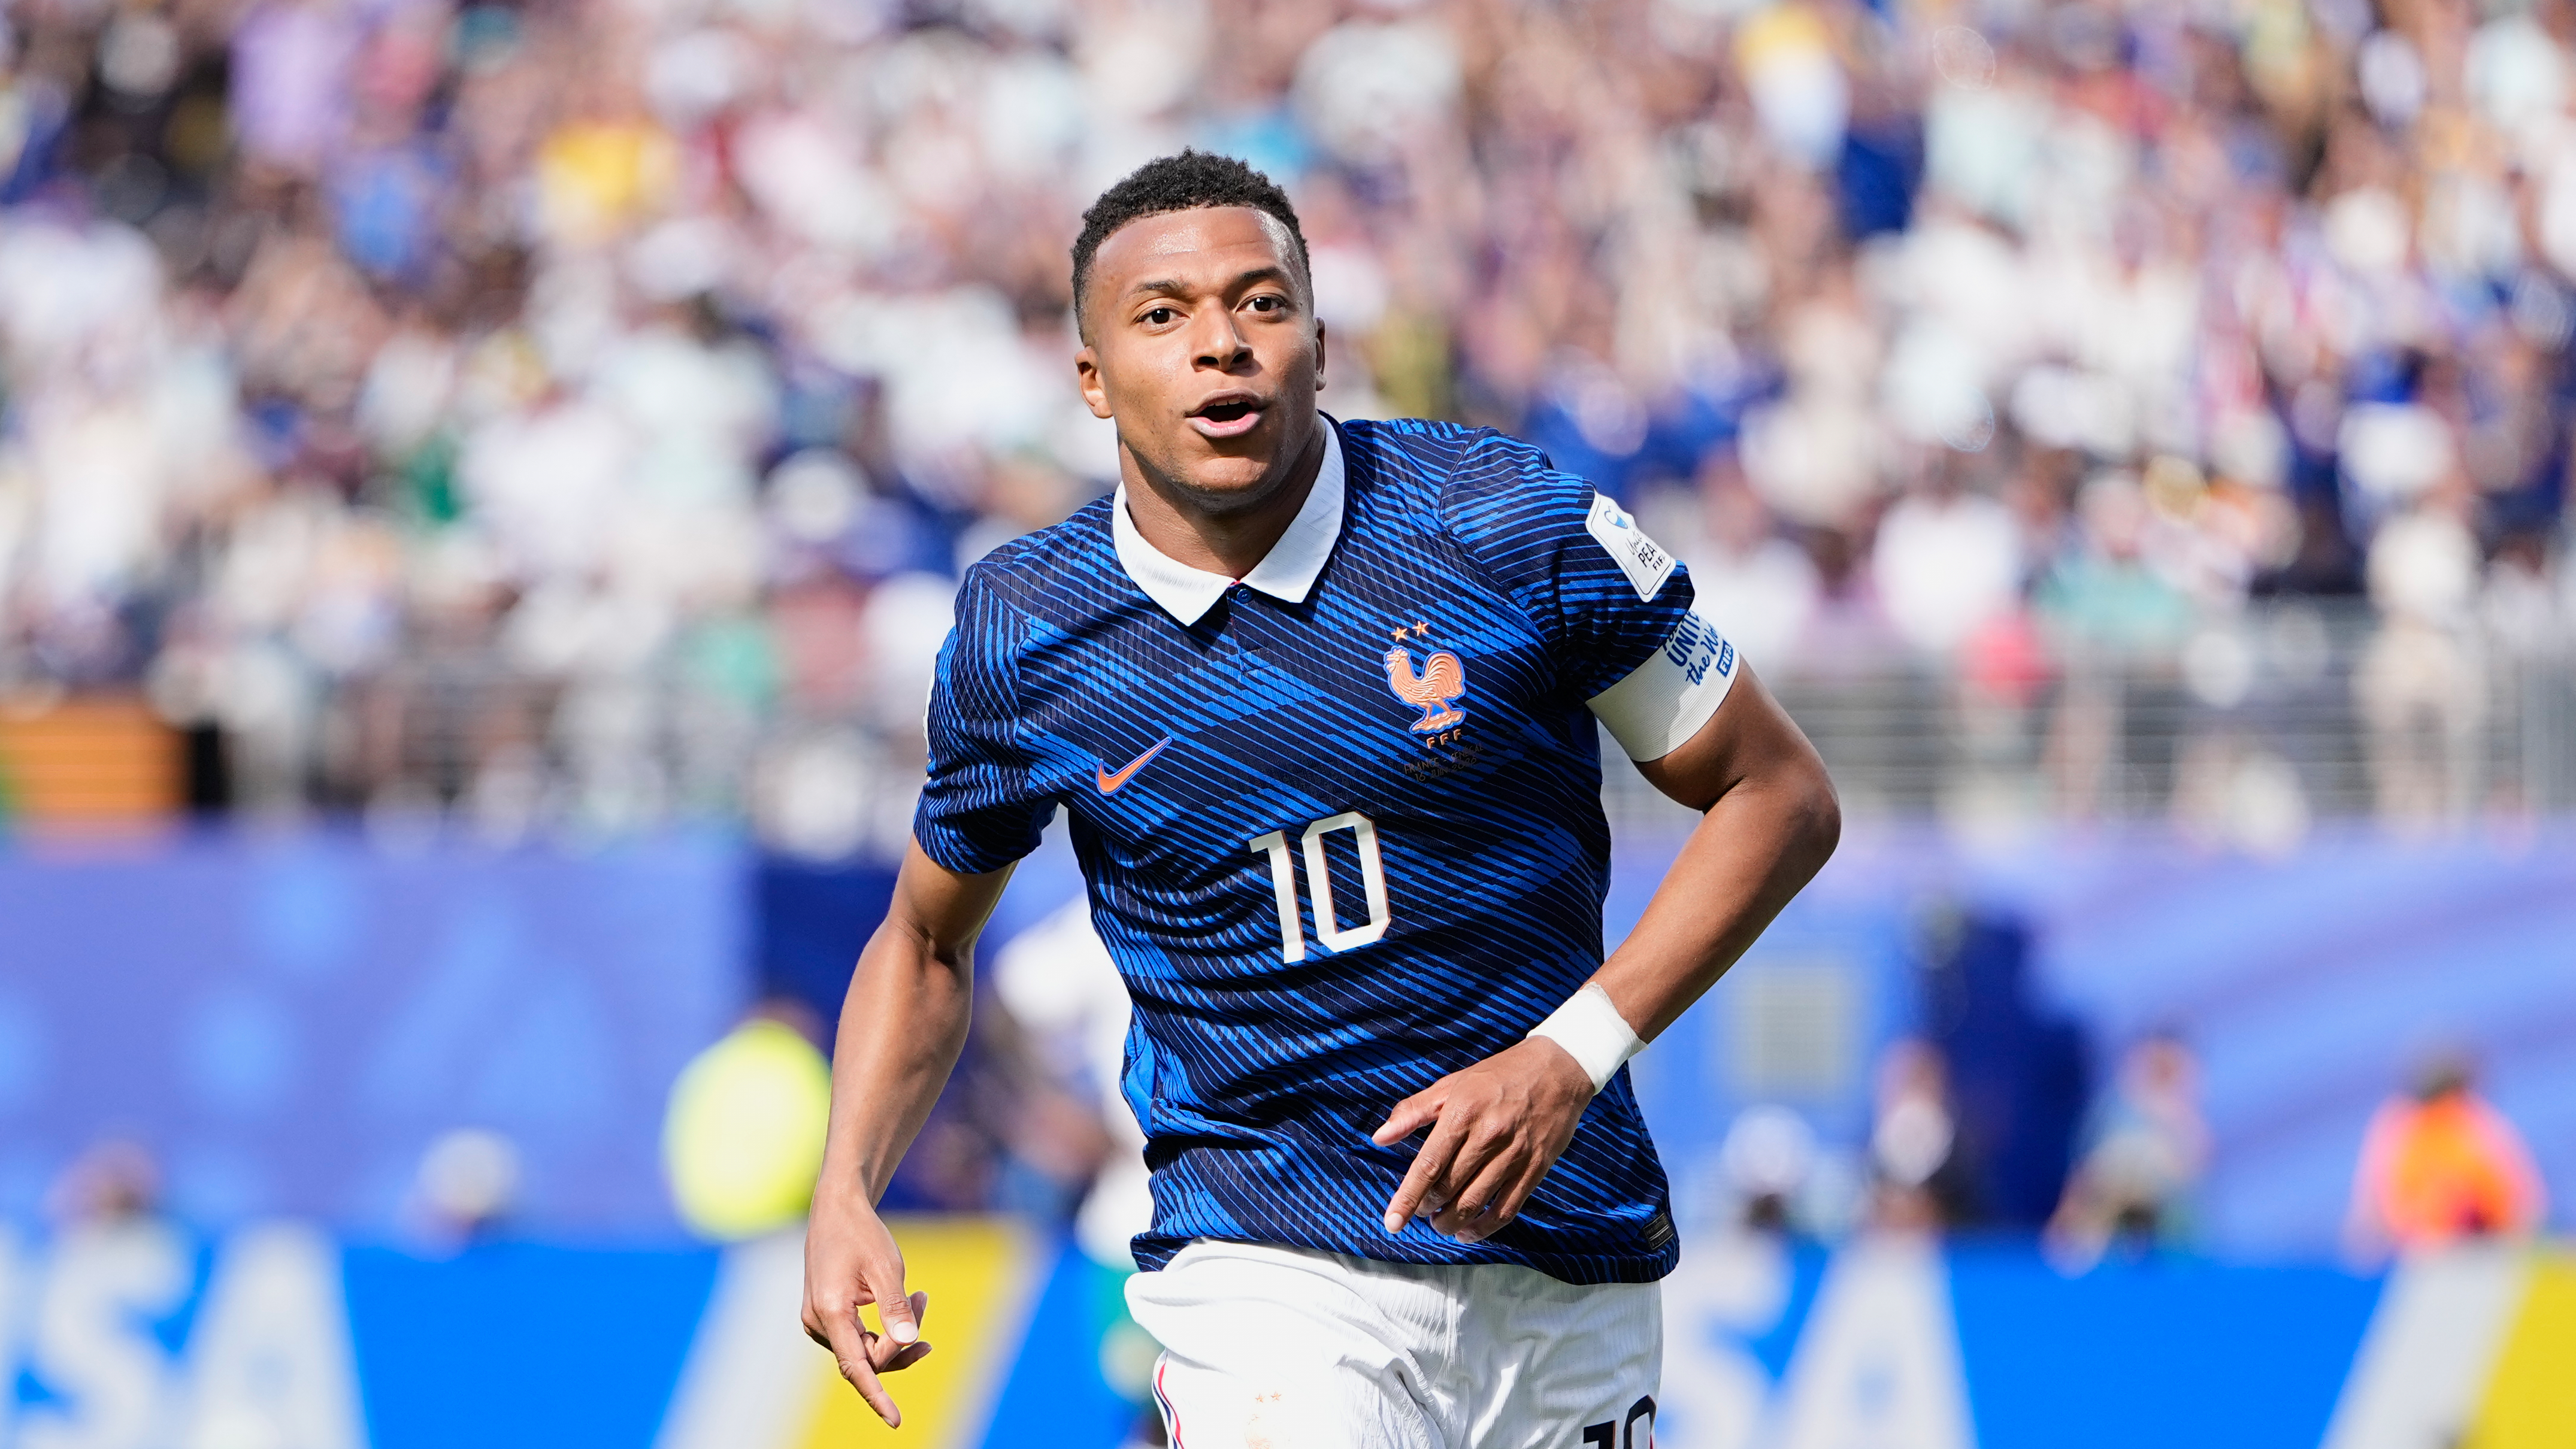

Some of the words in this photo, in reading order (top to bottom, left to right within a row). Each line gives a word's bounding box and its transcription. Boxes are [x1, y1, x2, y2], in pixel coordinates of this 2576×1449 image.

[1637, 542, 1657, 568] PEA
[1685, 654, 1711, 686] the
[1718, 643, 1733, 674] FIFA
[1248, 811, 1391, 964] 10
[0, 1221, 374, 1449] SA
